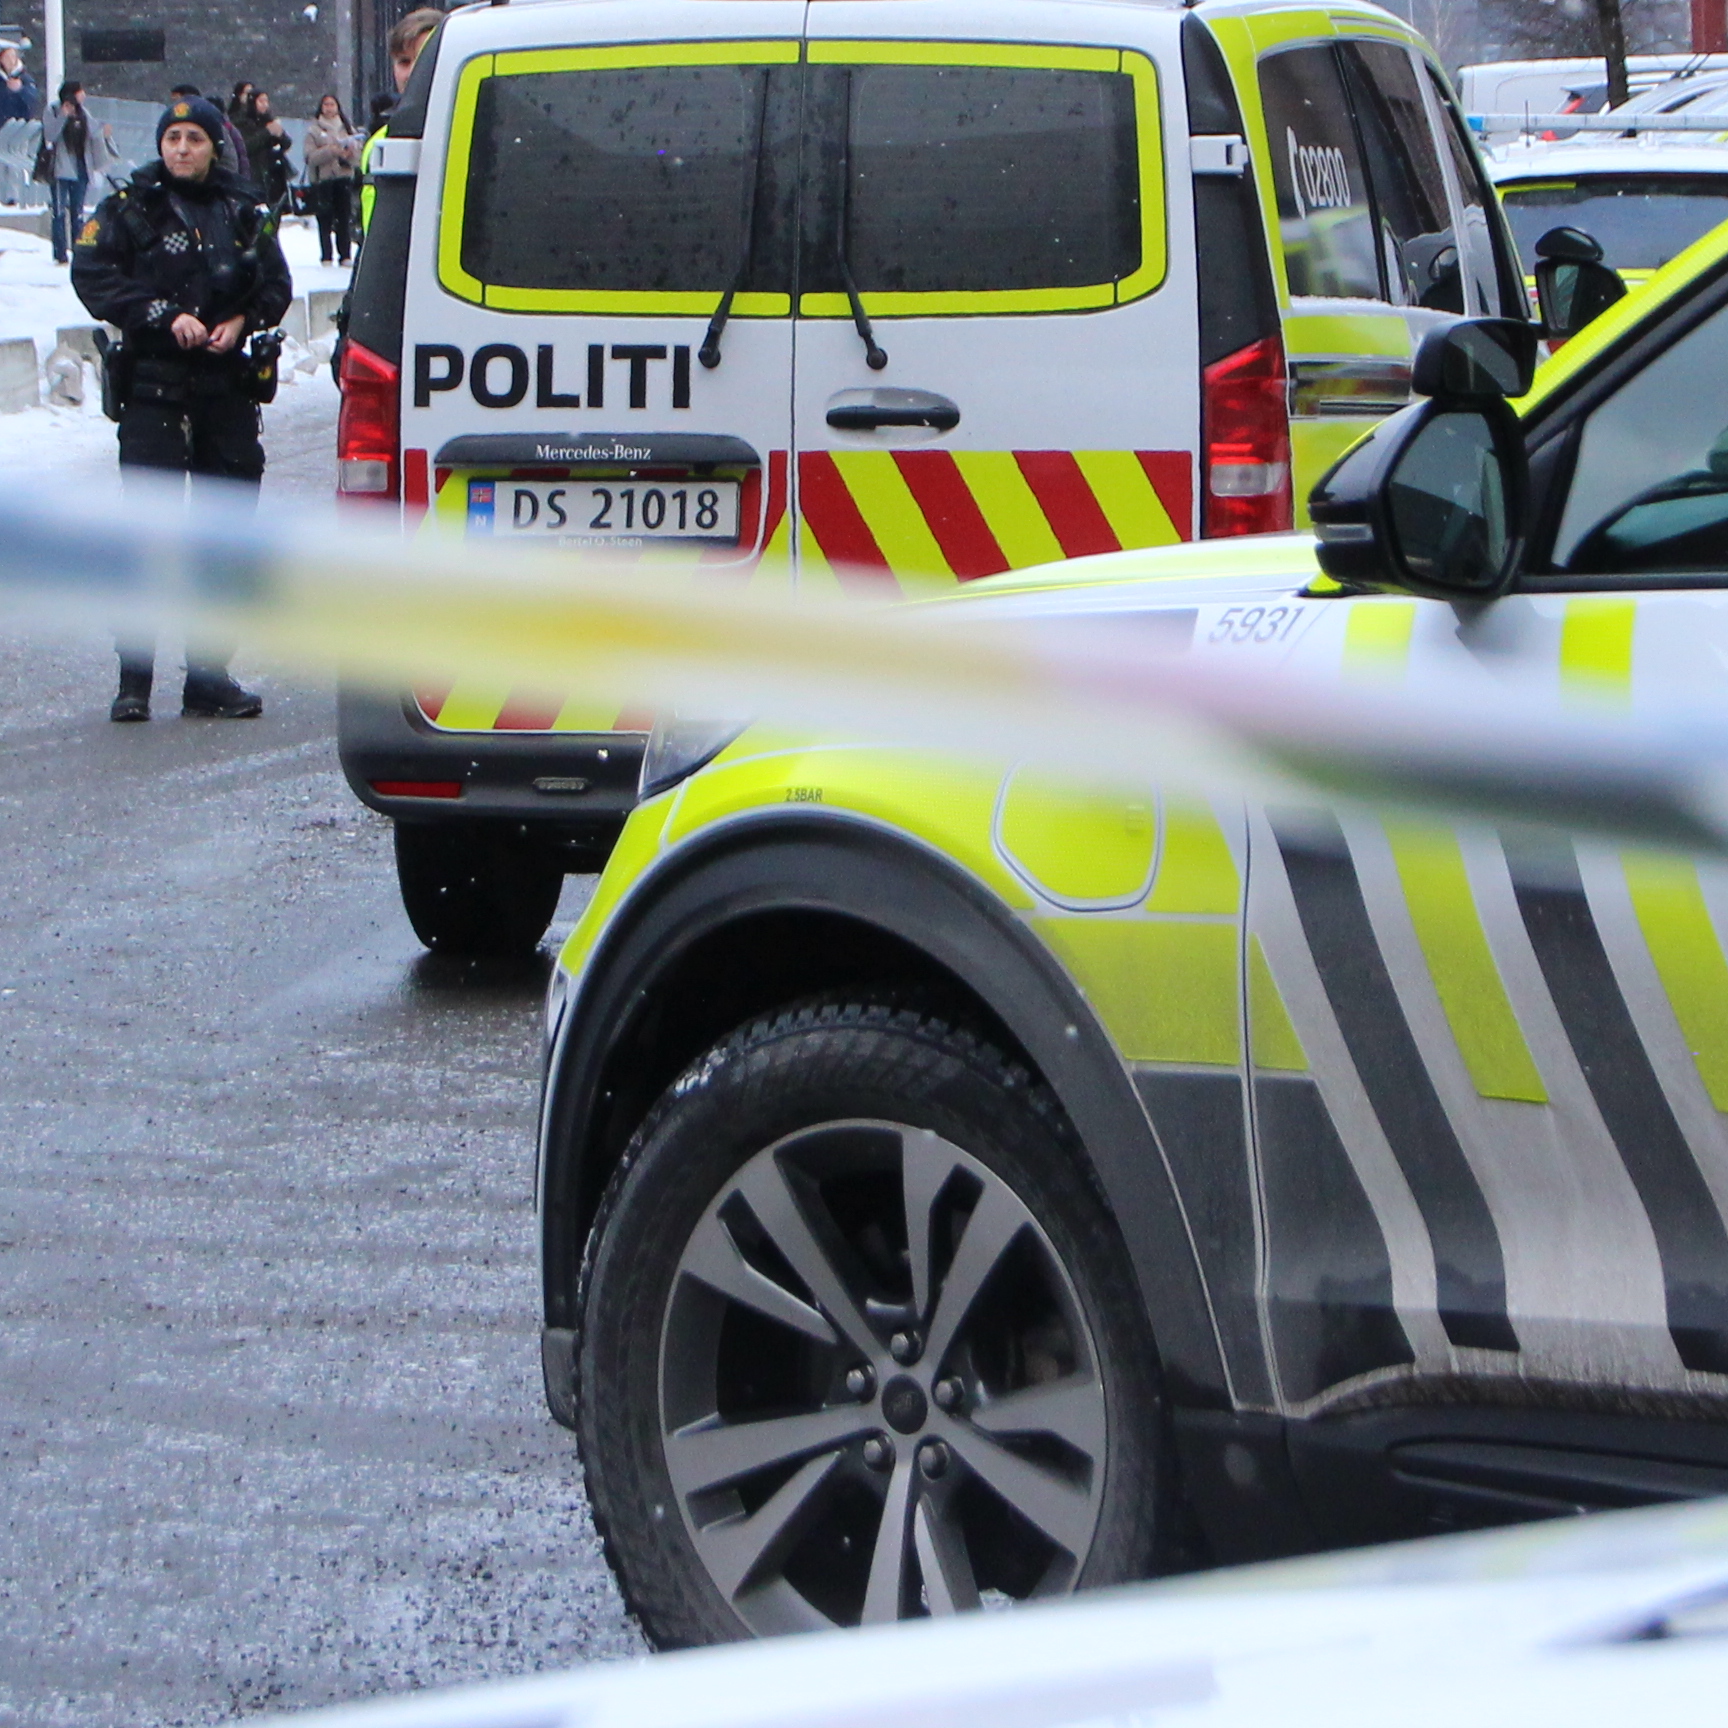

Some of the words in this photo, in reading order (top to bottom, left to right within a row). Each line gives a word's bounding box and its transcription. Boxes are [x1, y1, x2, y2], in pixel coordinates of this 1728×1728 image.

[1299, 145, 1351, 207] 02800
[414, 343, 690, 409] POLITI
[535, 444, 652, 461] Mercedes-Benz
[474, 516, 487, 527] N
[513, 488, 568, 529] DS
[589, 488, 719, 530] 21018
[1208, 606, 1306, 644] 5931
